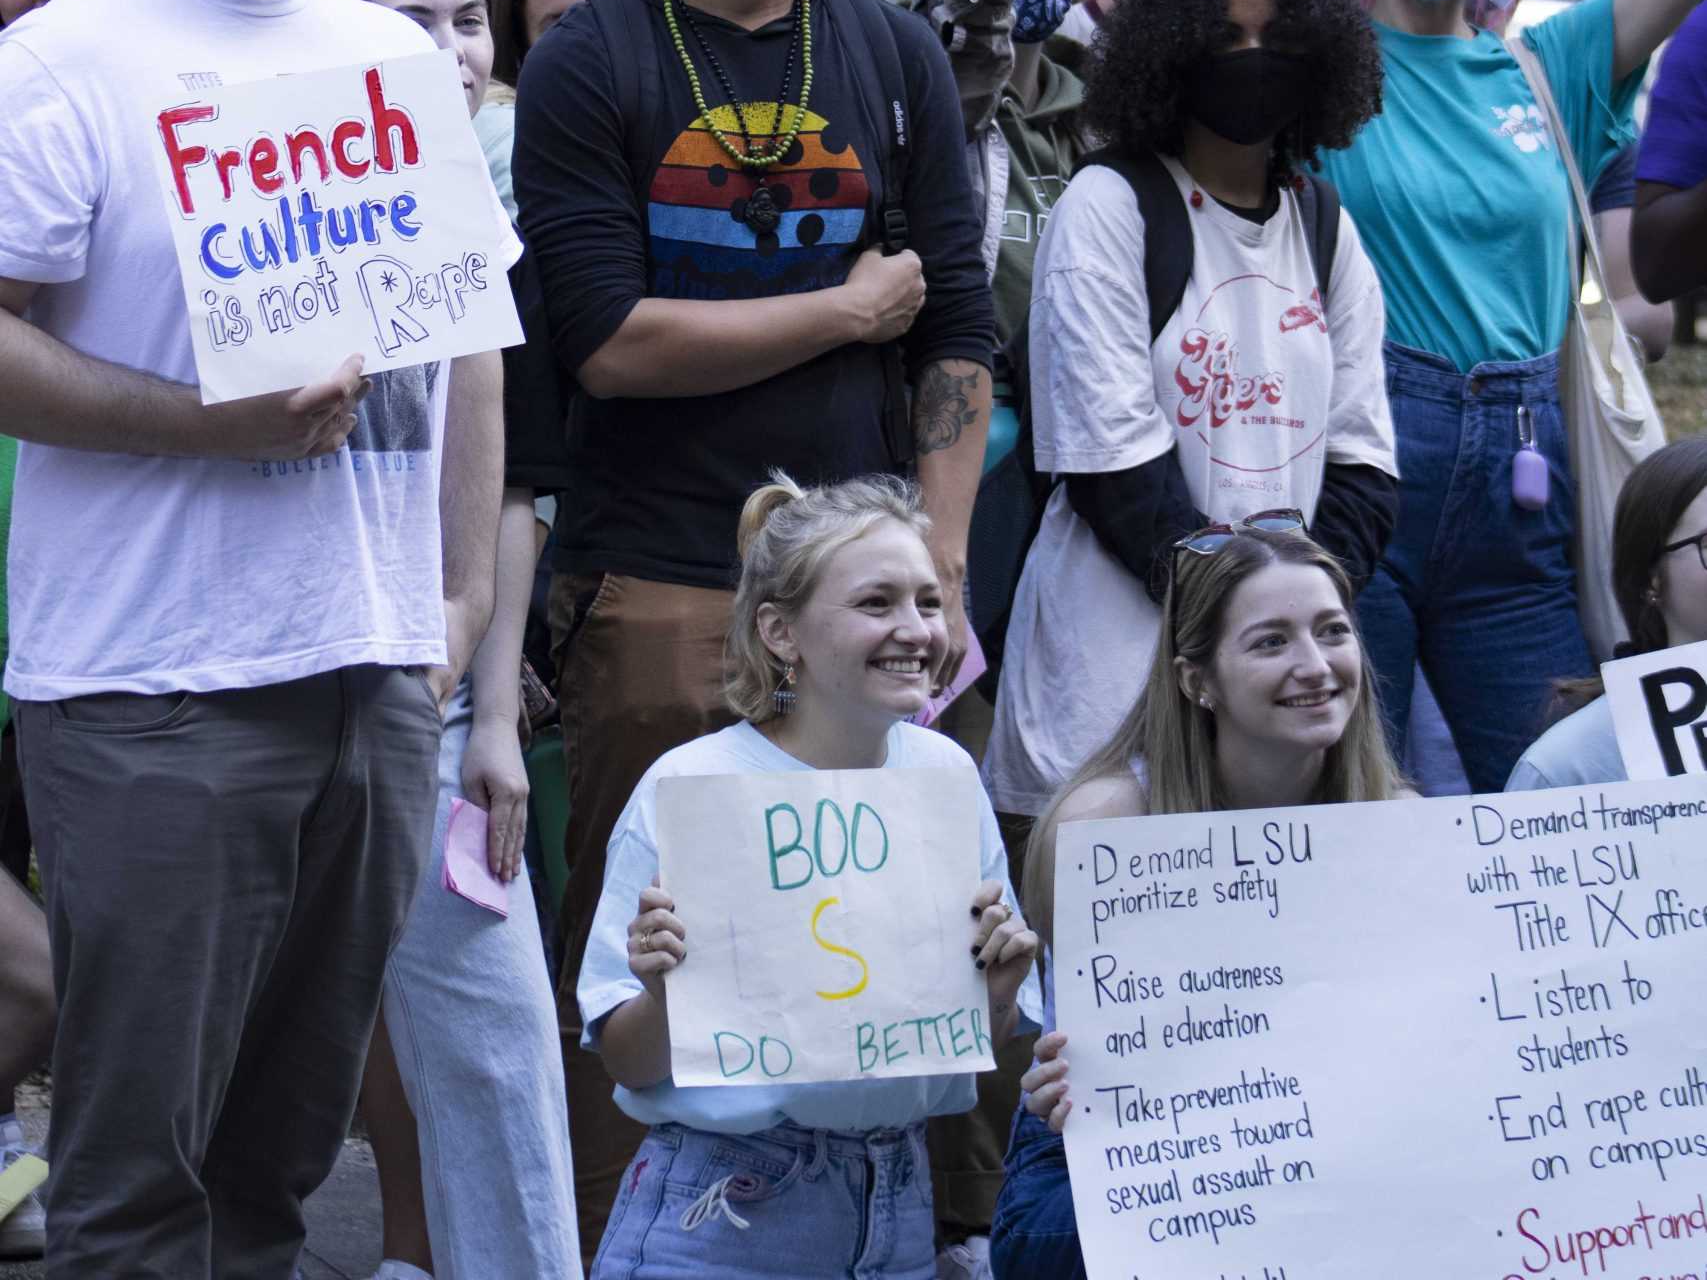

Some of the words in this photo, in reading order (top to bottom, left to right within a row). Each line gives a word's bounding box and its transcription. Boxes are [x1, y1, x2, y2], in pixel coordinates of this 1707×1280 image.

[157, 64, 425, 220] French
[200, 190, 422, 280] culture
[203, 289, 252, 351] is
[259, 258, 337, 333] not
[1640, 667, 1707, 777] P
[764, 798, 889, 891] BOO
[1093, 827, 1213, 886] Demand
[1232, 821, 1312, 867] LSU
[1471, 796, 1588, 846] Demand
[1467, 854, 1519, 894] with
[1530, 853, 1569, 891] the
[1572, 841, 1640, 888] LSU
[1091, 880, 1199, 944] prioritize
[1215, 868, 1279, 919] safety
[1494, 899, 1570, 952] Title
[1585, 889, 1639, 948] IX
[811, 896, 869, 1001] S
[1091, 954, 1165, 1009] Raise
[1179, 962, 1284, 994] awareness
[1491, 967, 1611, 1022] Listen
[1622, 959, 1653, 1006] to
[713, 1030, 793, 1079] DO
[856, 1007, 993, 1073] BETTER
[1105, 1016, 1147, 1058] and
[1162, 1005, 1271, 1050] education
[1517, 1025, 1628, 1074] students
[1095, 1084, 1166, 1129] Take
[1171, 1066, 1302, 1134] preventative
[1495, 1092, 1568, 1143] End
[1584, 1088, 1648, 1136] rape
[1105, 1130, 1222, 1172] measures
[1231, 1102, 1314, 1152] toward
[1531, 1150, 1570, 1182] on
[1589, 1132, 1707, 1182] campus
[1106, 1169, 1182, 1215] sexual
[1193, 1154, 1275, 1197] assault
[1283, 1157, 1315, 1183] on
[1148, 1203, 1256, 1245] campus
[1516, 1200, 1658, 1275] Support
[1659, 1193, 1707, 1240] and
